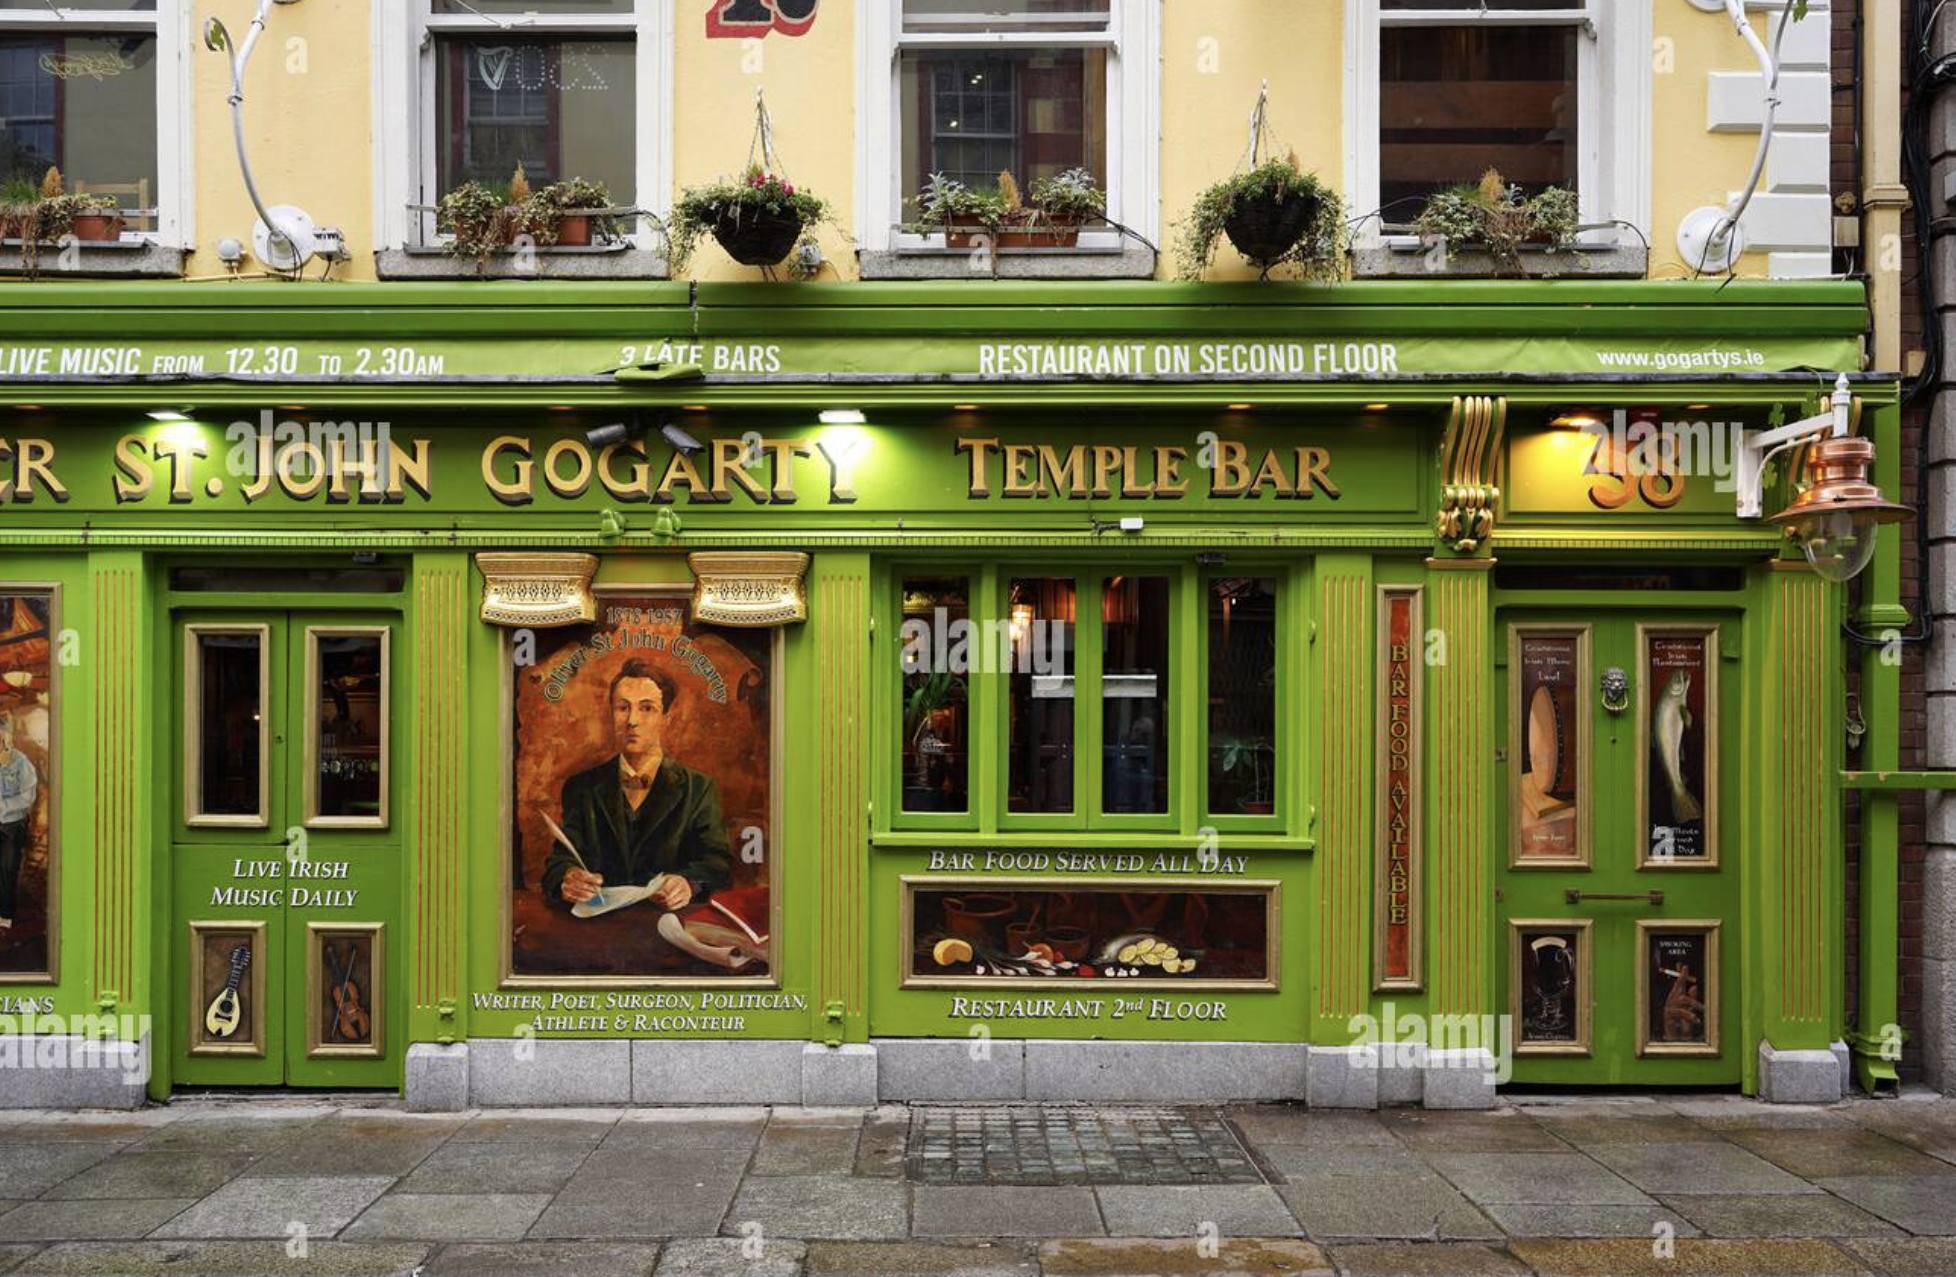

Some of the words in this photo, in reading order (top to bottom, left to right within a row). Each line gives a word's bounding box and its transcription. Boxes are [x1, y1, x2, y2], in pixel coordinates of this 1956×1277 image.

[0, 347, 51, 375] LIVE
[60, 347, 141, 375] MUSIC
[153, 355, 204, 374] FROM
[226, 347, 297, 375] 12.30
[319, 354, 341, 375] TO
[355, 347, 443, 375] 2.30AM
[620, 345, 636, 366] 3
[643, 342, 703, 368] LATE
[713, 345, 780, 372] BARS
[979, 344, 1147, 375] RESTAURANT
[1155, 345, 1190, 374] ON
[1199, 344, 1305, 374] SECOND
[1314, 343, 1397, 373] FLOOR
[1597, 348, 1765, 370] www.gogartys.ie
[112, 433, 224, 500] ST.
[240, 437, 432, 503] JOHN
[481, 434, 860, 503] GOGARTY
[954, 437, 1191, 498] TEMPLE
[1208, 438, 1342, 499] BAR
[544, 643, 590, 701] Oliver
[591, 632, 613, 655] St
[619, 629, 666, 651] John
[672, 635, 727, 703] Gogarty
[1391, 644, 1408, 696] BAR
[1391, 704, 1408, 771] FOOD
[927, 851, 975, 872] BAR
[984, 851, 1050, 873] FOOD
[1055, 851, 1145, 874] SERVED
[1149, 852, 1193, 874] ALL
[1200, 853, 1250, 875] DAY
[1391, 780, 1408, 925] AVAILABLE
[233, 859, 281, 878] LIVE
[288, 859, 349, 879] IRISH
[211, 887, 282, 907] MUSIC
[289, 887, 358, 907] DAILY
[0, 996, 55, 1014] IANS
[472, 993, 546, 1012] WRITER,
[549, 993, 601, 1013] POET,
[604, 992, 695, 1013] SURGEON,
[700, 992, 808, 1013] POLITICIAN,
[949, 996, 1104, 1019] RESTAURANT
[1111, 997, 1143, 1018] 2nd
[1148, 999, 1228, 1021] FLOOR
[530, 1013, 608, 1032] ATHLETE
[614, 1014, 629, 1031] &
[632, 1013, 746, 1032] RACONTEUR
